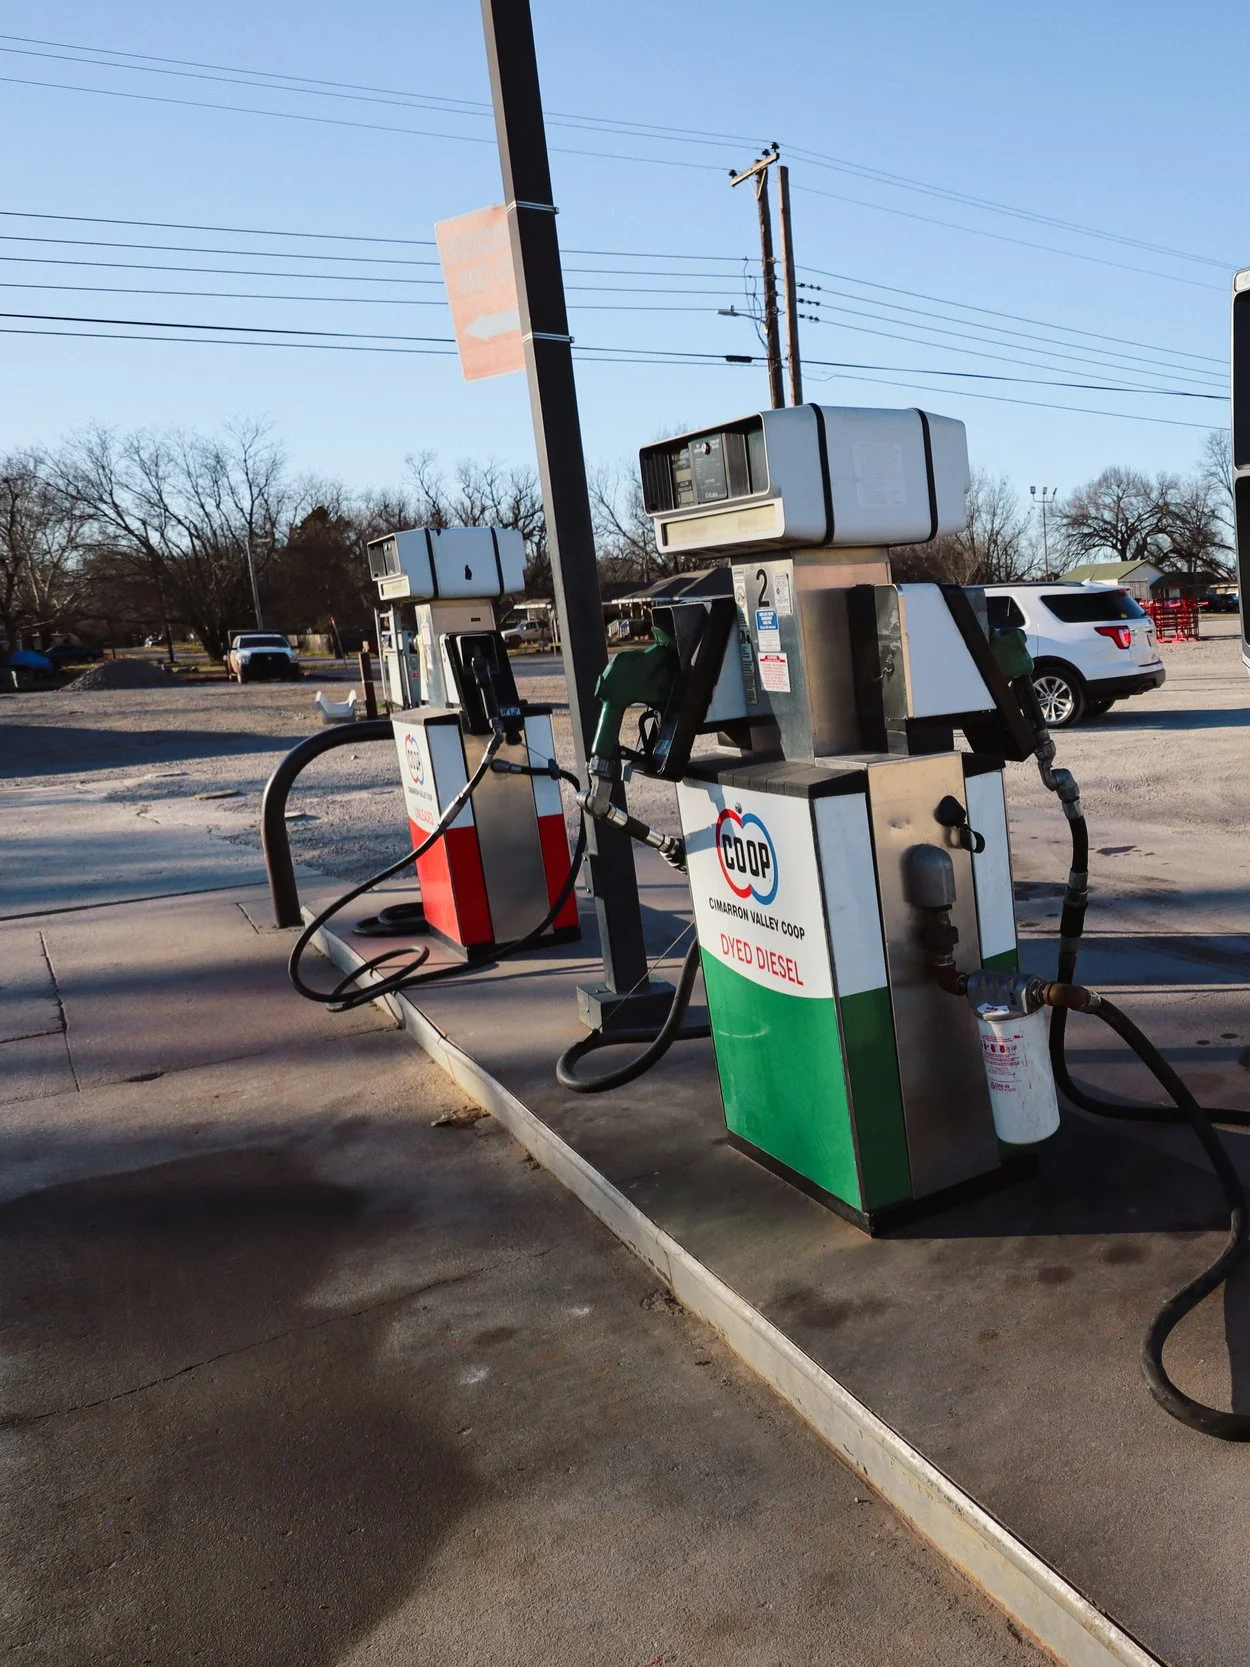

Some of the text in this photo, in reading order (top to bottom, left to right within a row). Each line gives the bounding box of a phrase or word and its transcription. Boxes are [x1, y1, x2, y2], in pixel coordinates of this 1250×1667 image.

[756, 568, 770, 607] 2
[722, 834, 770, 878] COOP
[708, 897, 805, 940] CIMARRON VALLEY COOP
[720, 933, 804, 986] DYED DIESEL
